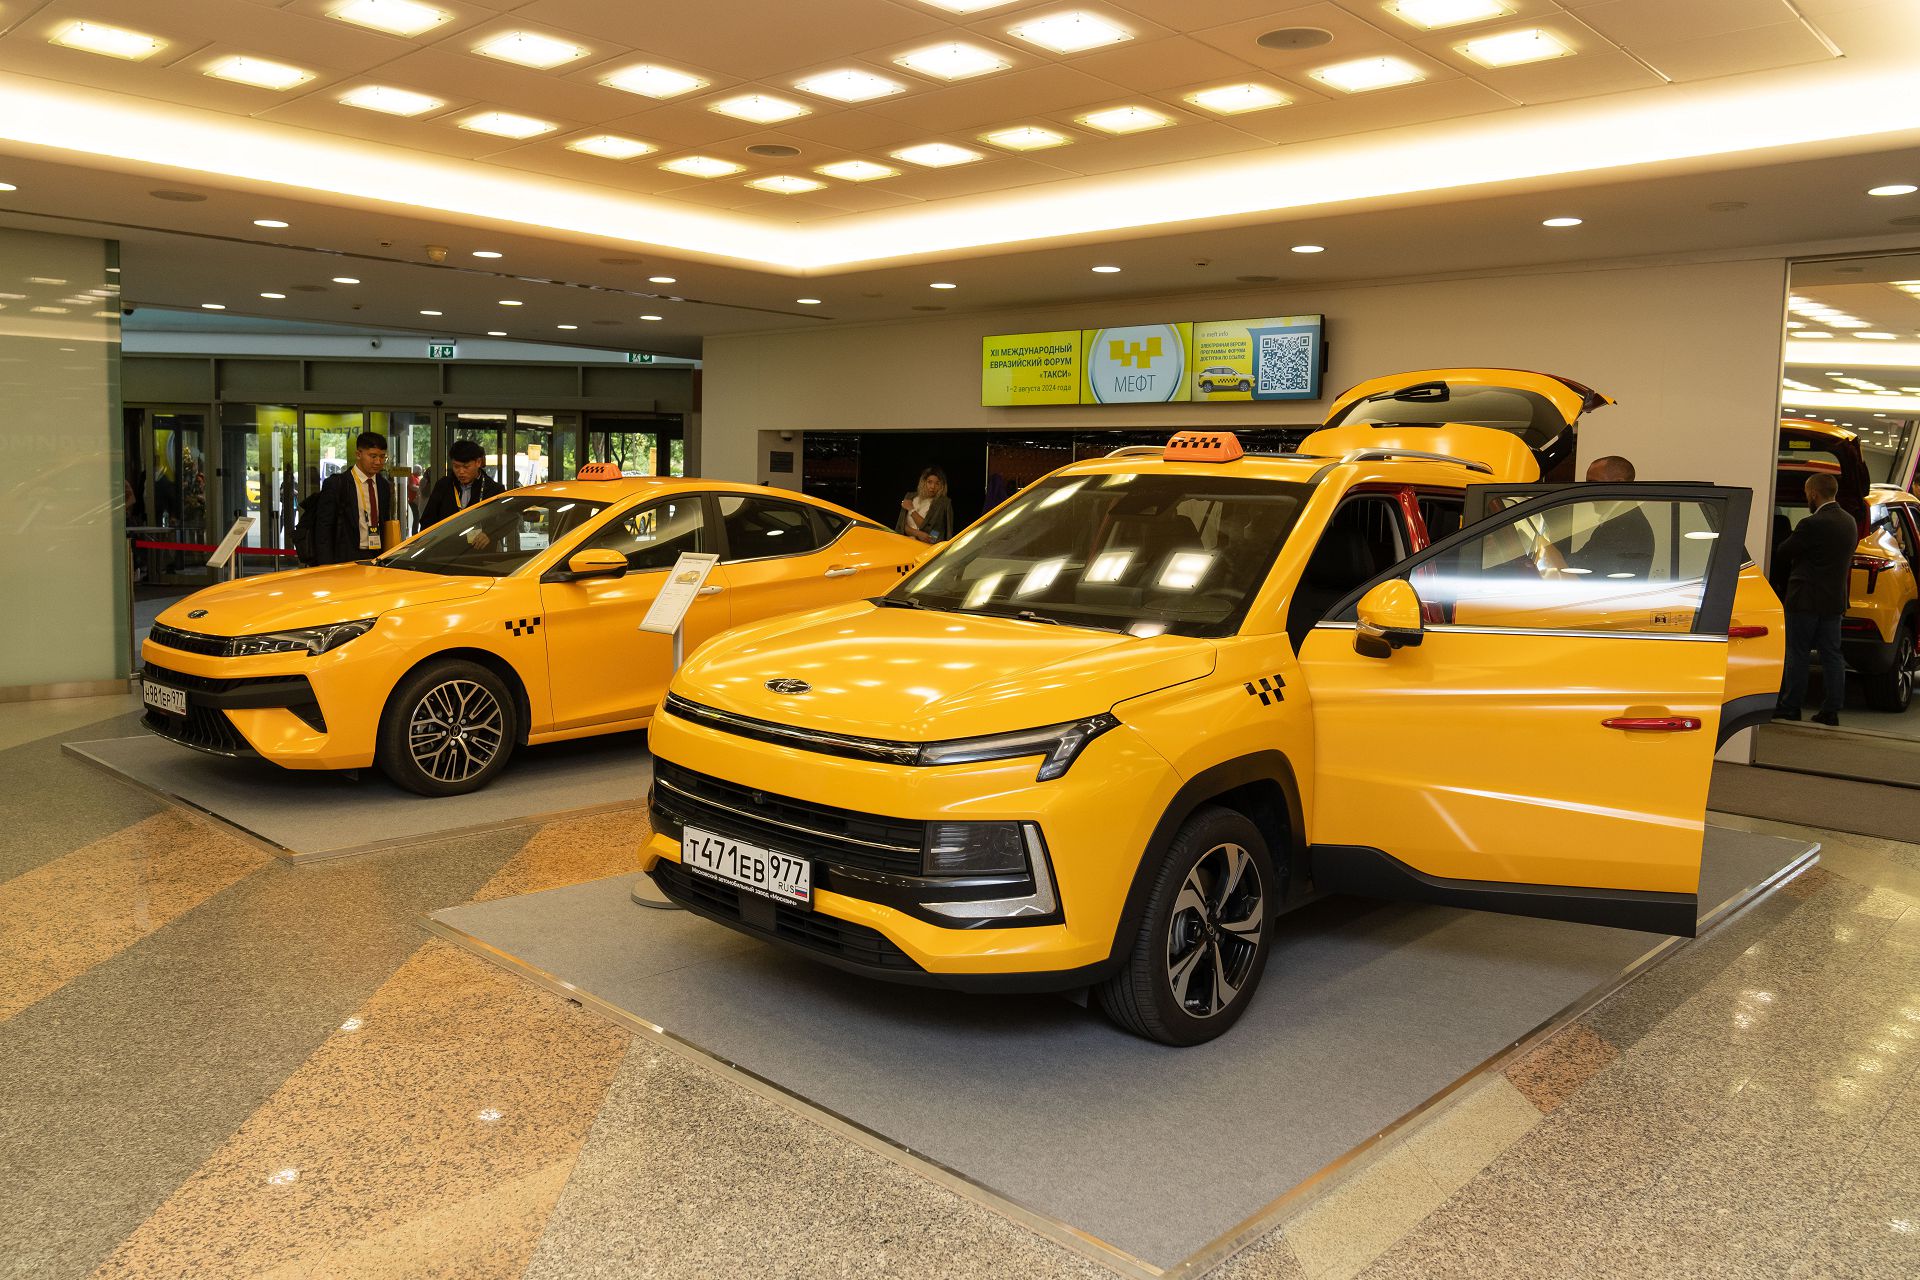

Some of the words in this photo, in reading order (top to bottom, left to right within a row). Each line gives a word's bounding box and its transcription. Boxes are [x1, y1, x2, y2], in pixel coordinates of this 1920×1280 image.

[1000, 343, 1072, 356] МЕЖДУНАРОДНЫЙ
[990, 356, 1043, 369] ЕВРАЗИЙСКИЙ
[1043, 357, 1073, 367] ФОРУМ
[1039, 369, 1072, 379] «ТАКСИ»
[1018, 385, 1041, 394] августа
[1042, 384, 1056, 392] 2024
[1057, 384, 1072, 393] года
[1114, 374, 1157, 392] МЕФТ
[770, 855, 804, 886] 977
[778, 881, 795, 894] RUS
